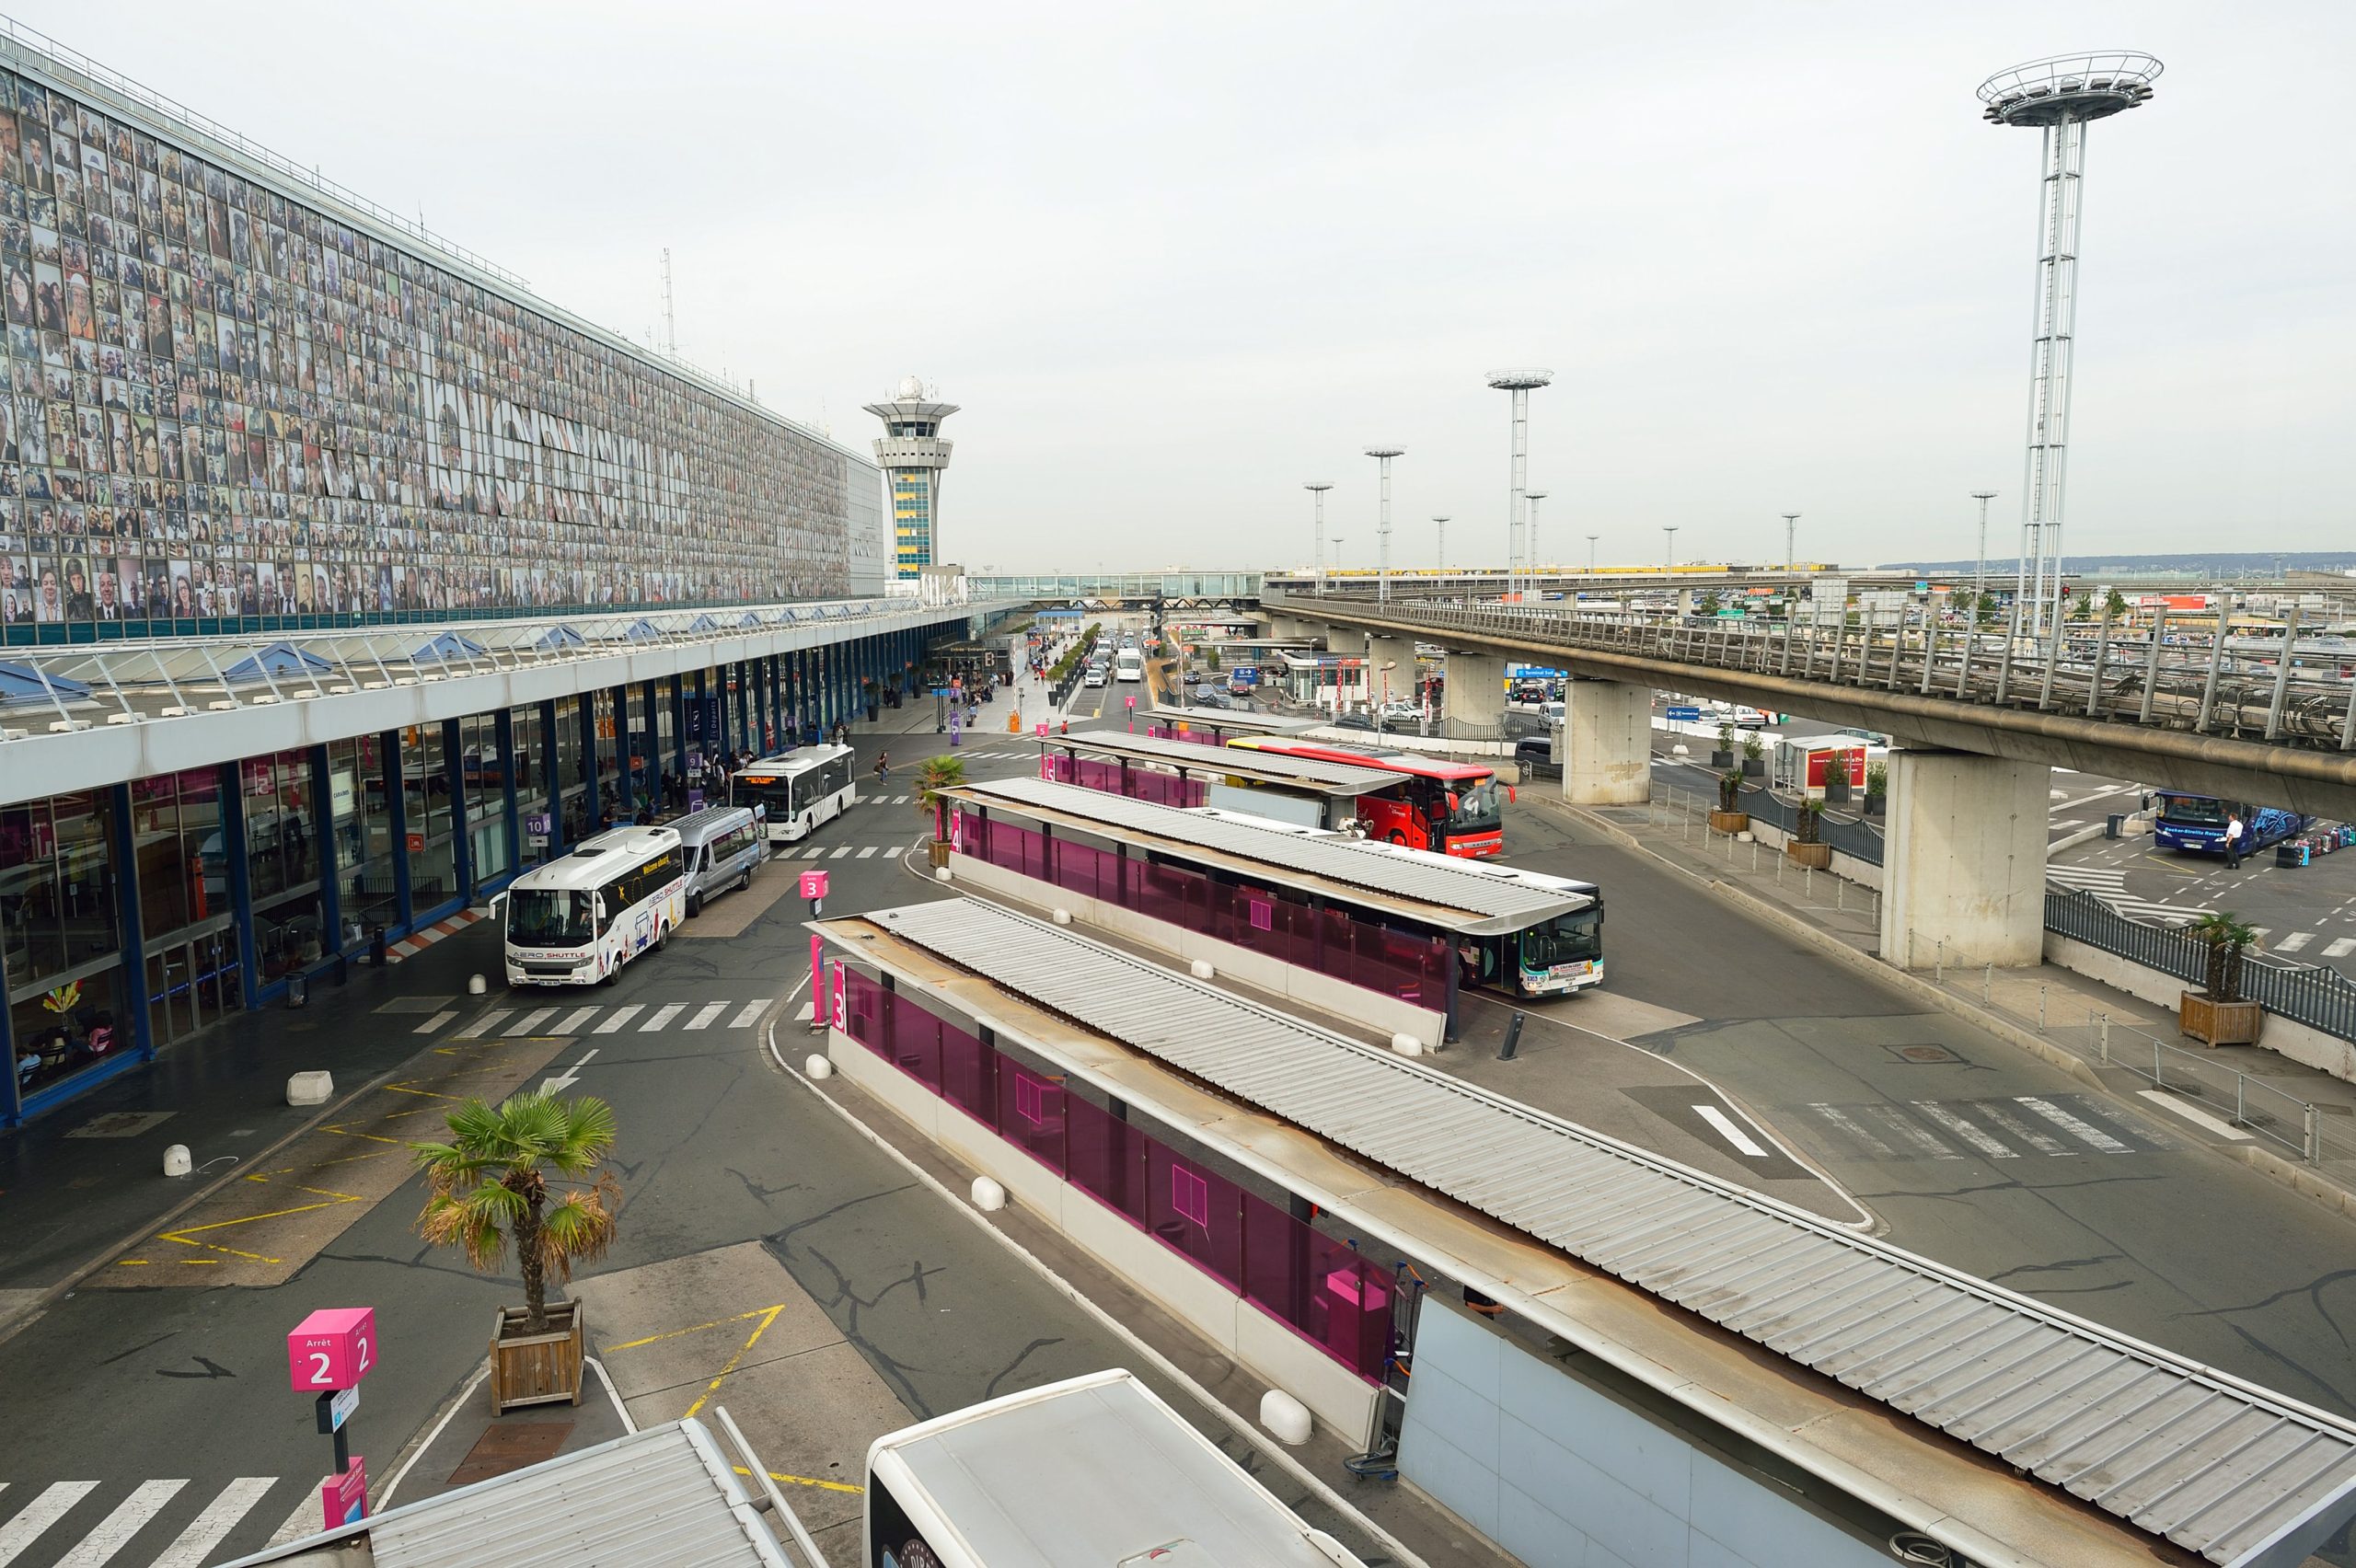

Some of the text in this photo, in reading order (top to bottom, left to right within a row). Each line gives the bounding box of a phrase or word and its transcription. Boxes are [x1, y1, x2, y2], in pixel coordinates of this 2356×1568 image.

[985, 651, 995, 666] B
[689, 757, 696, 766] 9
[1047, 768, 1054, 781] 5
[527, 821, 542, 833] 10
[953, 829, 960, 851] 4
[643, 854, 670, 875] Welcome aboard
[664, 879, 683, 895] SHUTTLE
[807, 882, 817, 896] 3
[835, 992, 844, 1030] 3
[306, 1339, 331, 1347] Arrêt
[357, 1336, 369, 1373] 2
[309, 1352, 333, 1384] 2
[339, 1462, 364, 1494] Terminal Sud
